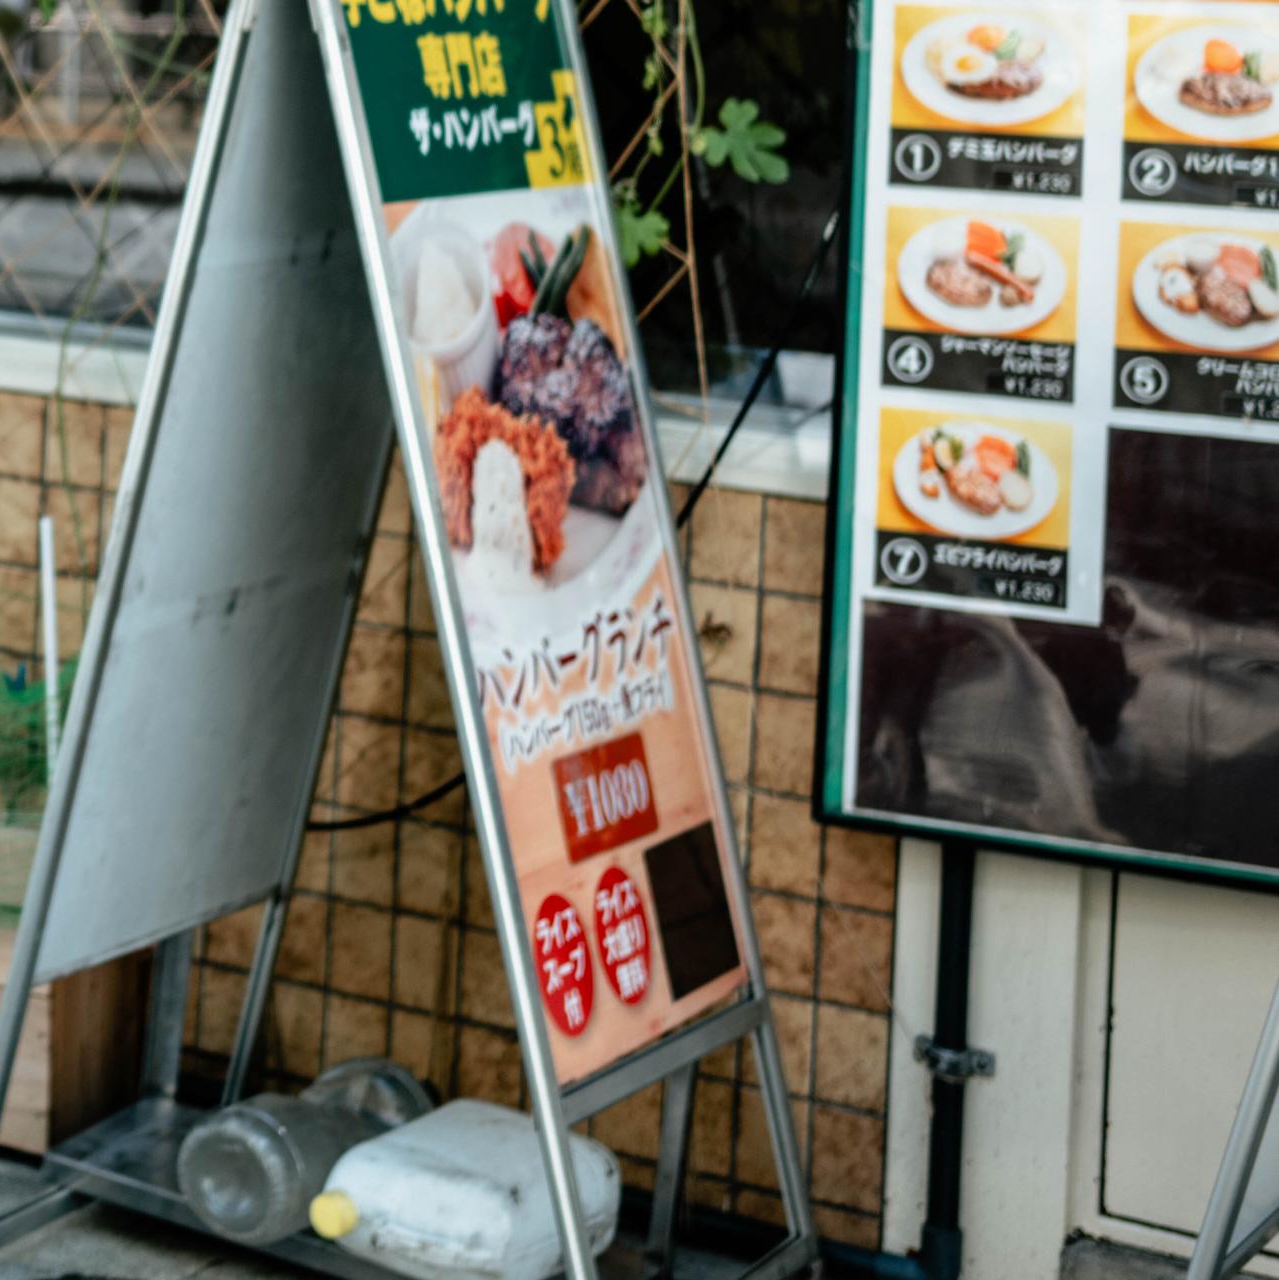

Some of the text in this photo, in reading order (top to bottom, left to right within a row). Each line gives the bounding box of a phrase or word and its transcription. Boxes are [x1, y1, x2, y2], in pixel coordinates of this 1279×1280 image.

[417, 32, 506, 99] 専門店
[536, 907, 581, 955] ライス
